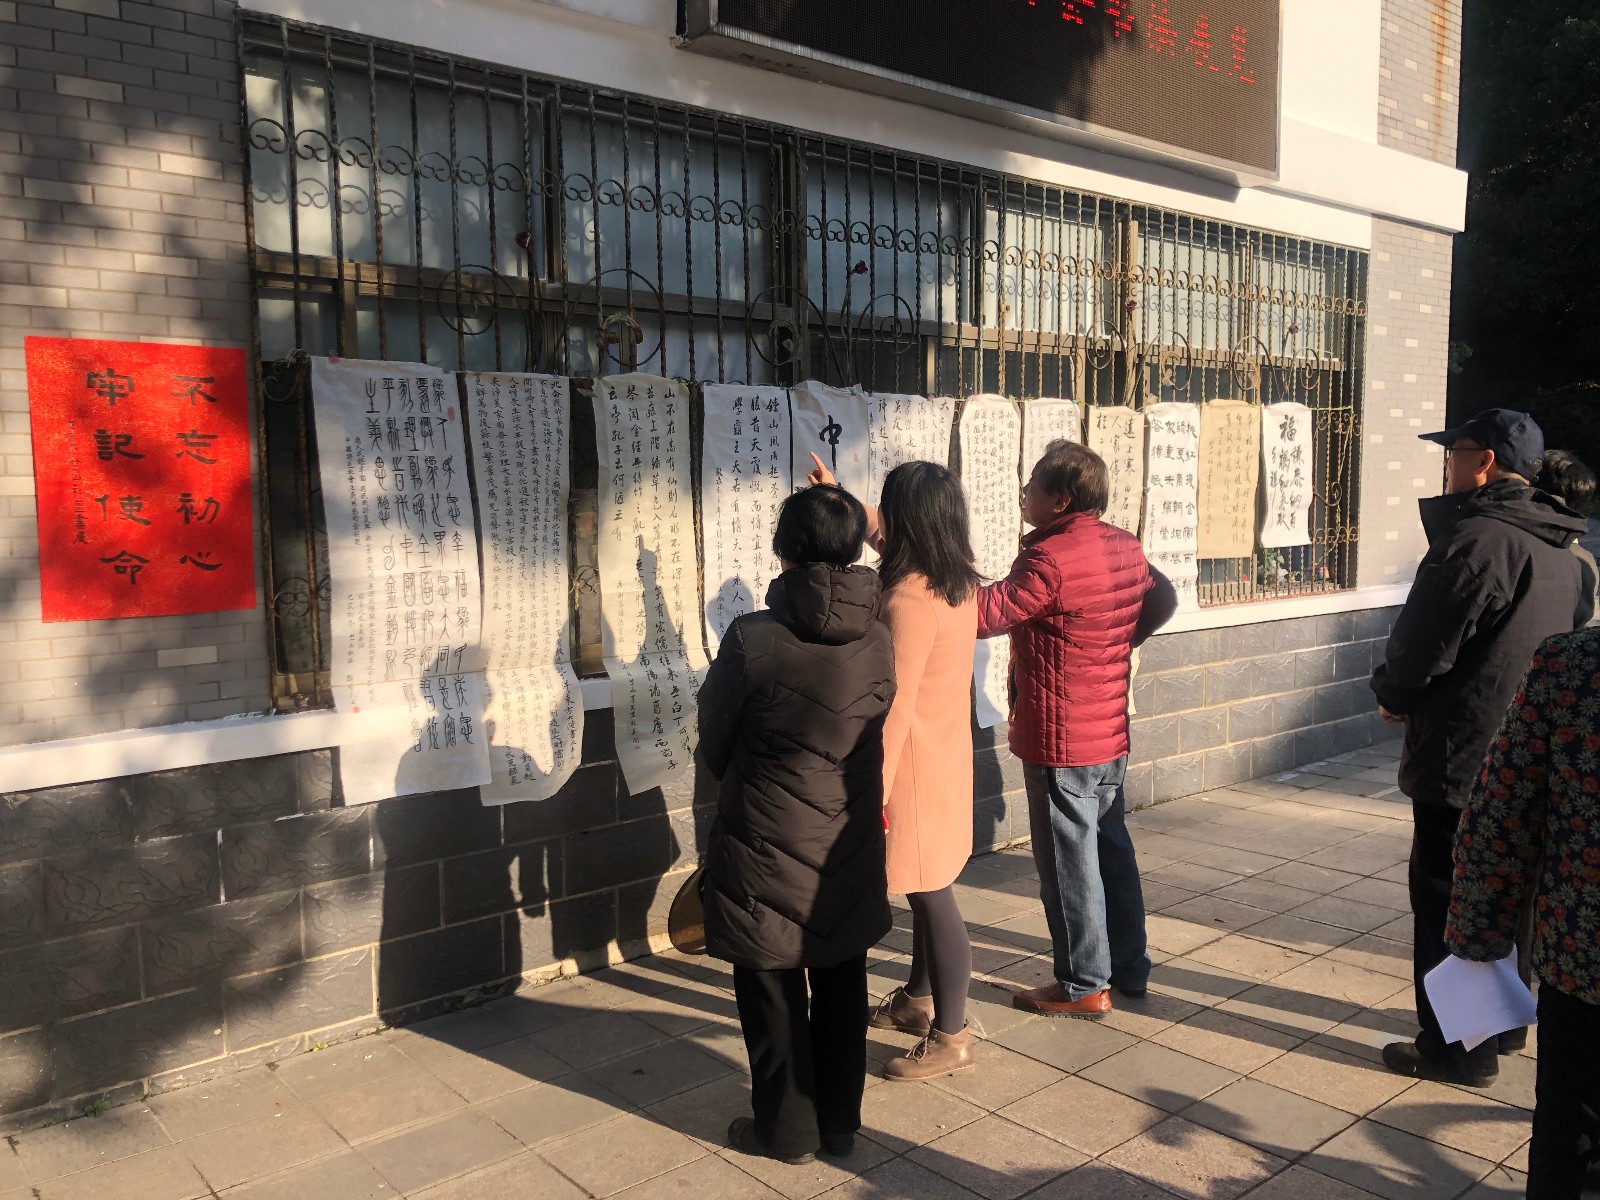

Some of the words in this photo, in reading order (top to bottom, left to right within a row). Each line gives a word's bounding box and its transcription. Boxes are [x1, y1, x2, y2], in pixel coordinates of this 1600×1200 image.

[170, 374, 223, 572] 不忘初心
[818, 414, 843, 472] 中
